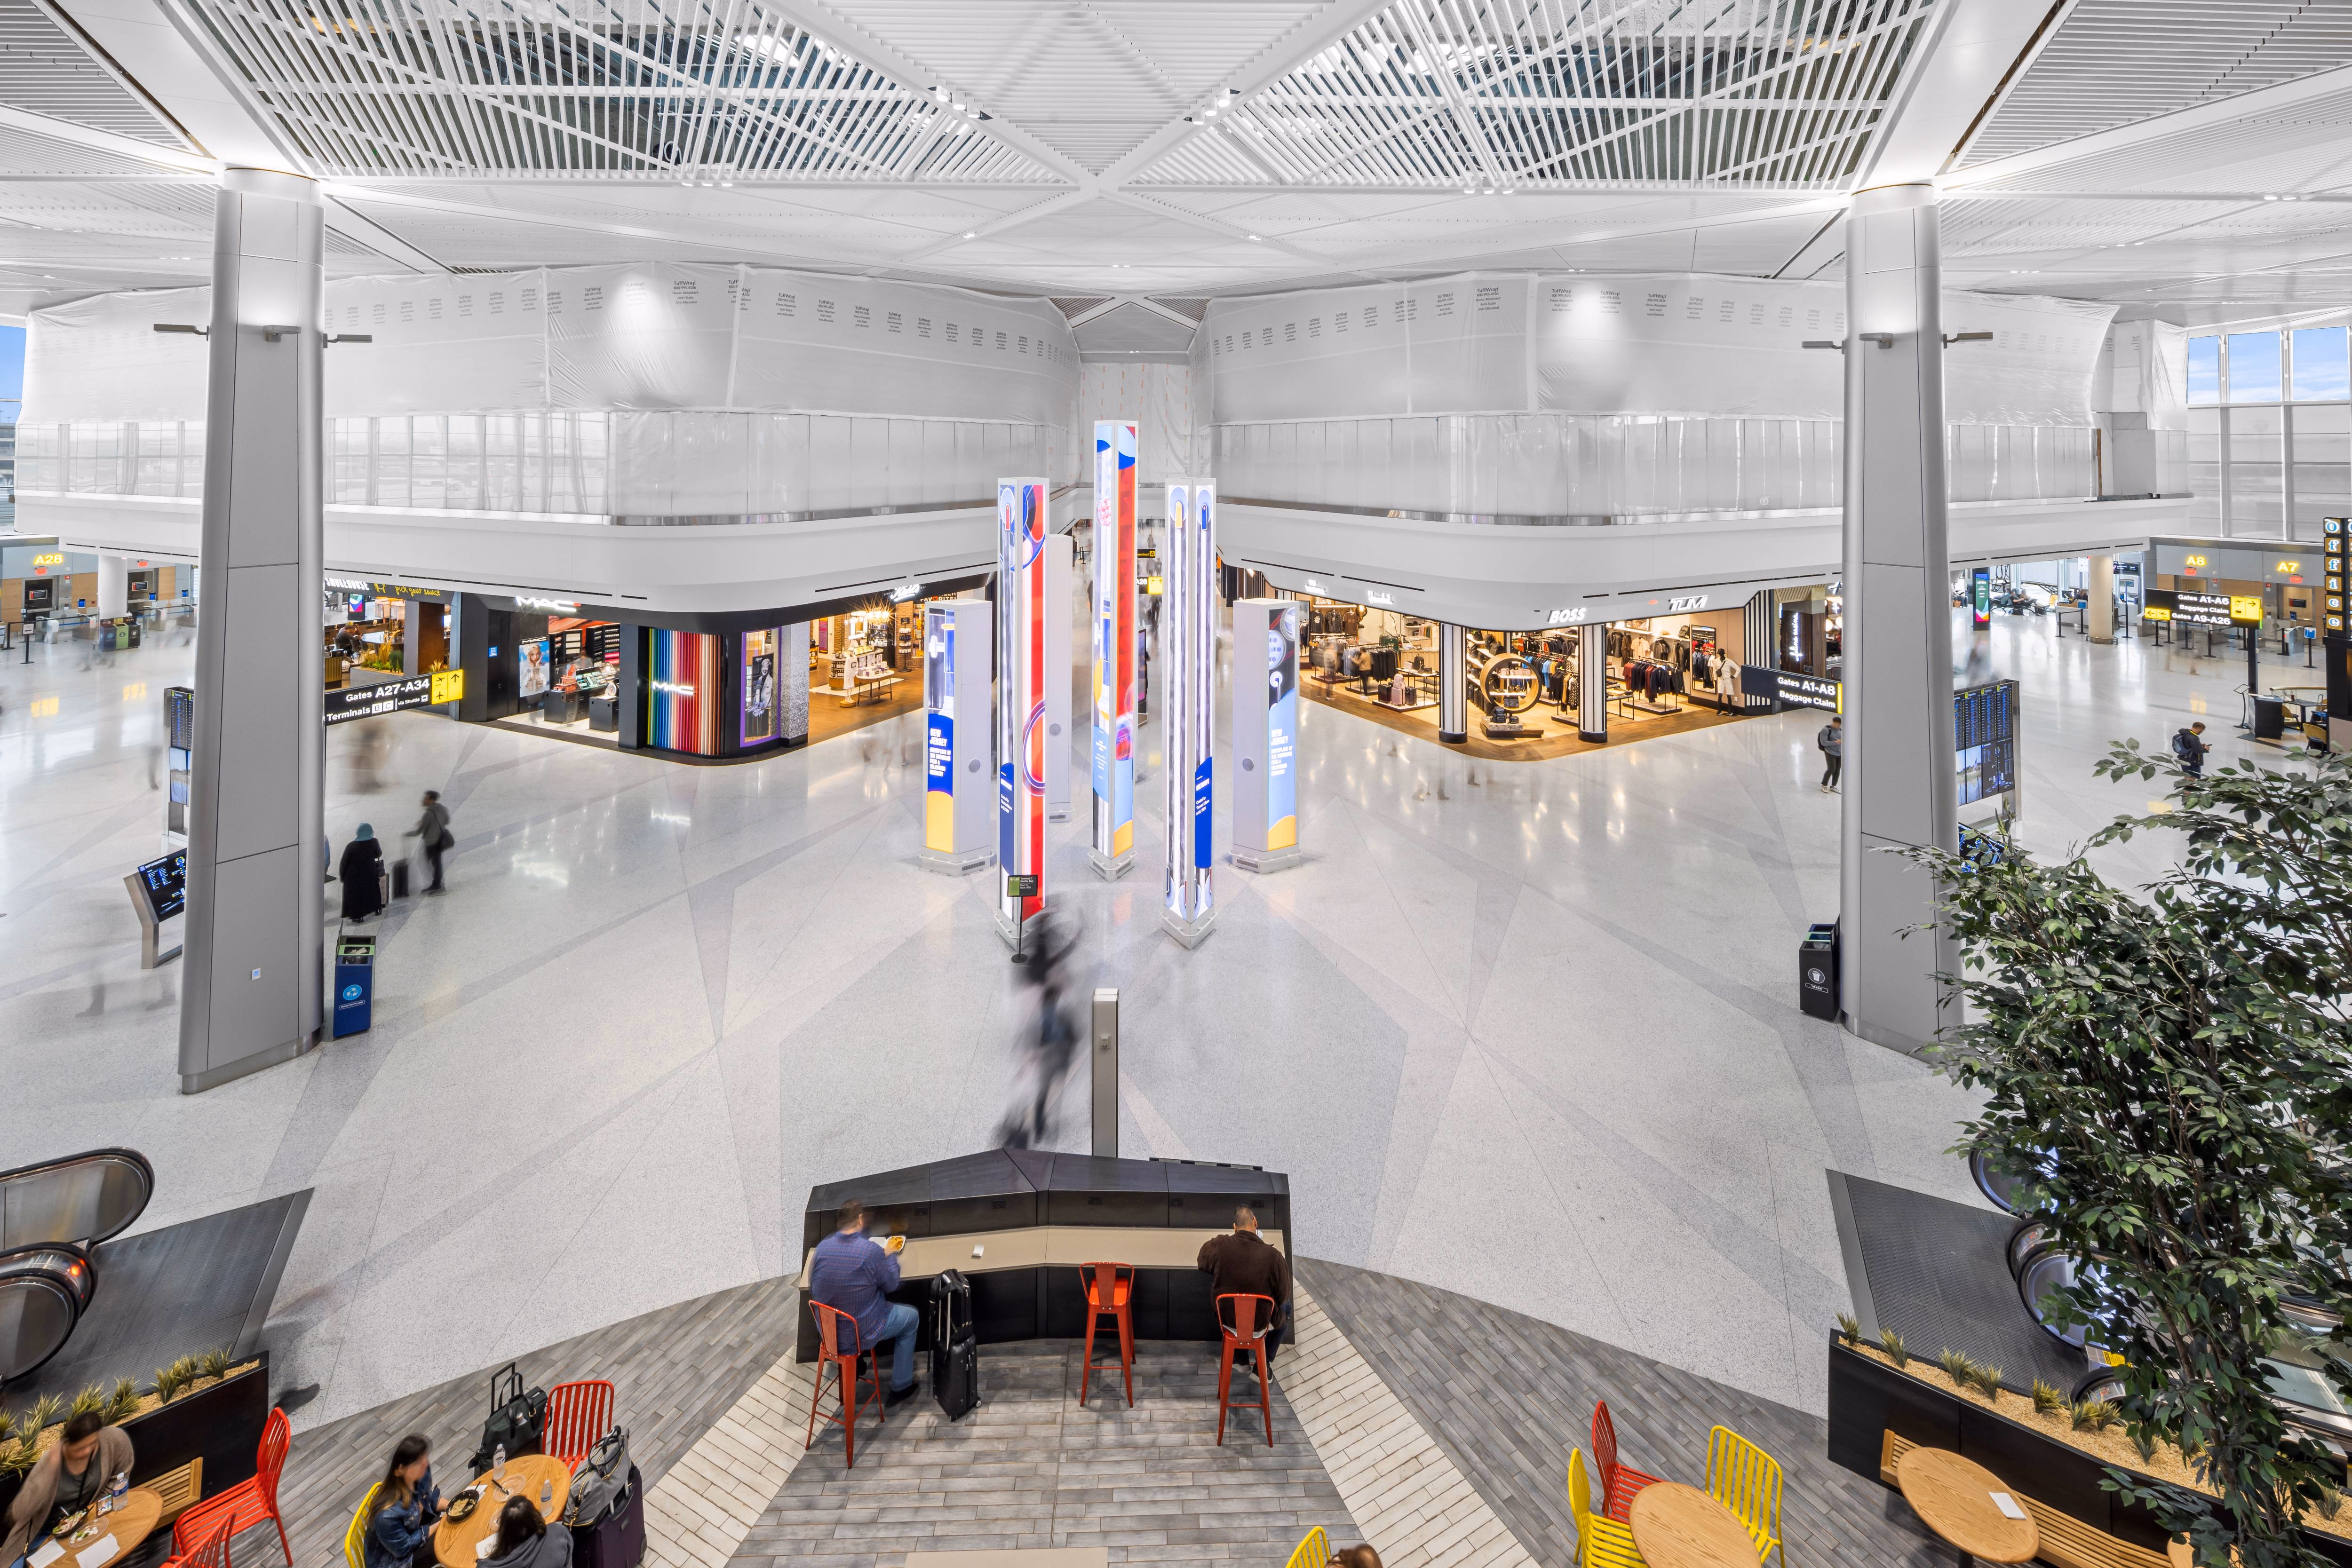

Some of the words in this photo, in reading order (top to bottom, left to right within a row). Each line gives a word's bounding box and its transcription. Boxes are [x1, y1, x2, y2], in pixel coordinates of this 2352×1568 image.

[34, 555, 63, 564] A28
[2187, 556, 2205, 565] A8
[2278, 562, 2299, 572] A7
[395, 586, 408, 594] pick
[409, 588, 421, 597] your
[1669, 595, 1708, 611] TUMI
[2200, 596, 2229, 605] A1-A6
[1549, 608, 1587, 624] BOSS
[2193, 615, 2230, 625] A9-A26
[346, 691, 372, 702] Gates
[375, 679, 430, 698] A27-A34
[1778, 677, 1800, 687] Gates
[1802, 681, 1836, 695] A1-A8
[1780, 690, 1812, 704] Baggage
[1813, 697, 1836, 708] Claim
[327, 707, 371, 721] Terminals
[930, 728, 941, 737] NEW
[930, 736, 947, 746] JERSEY
[1271, 736, 1288, 746] JERSEY
